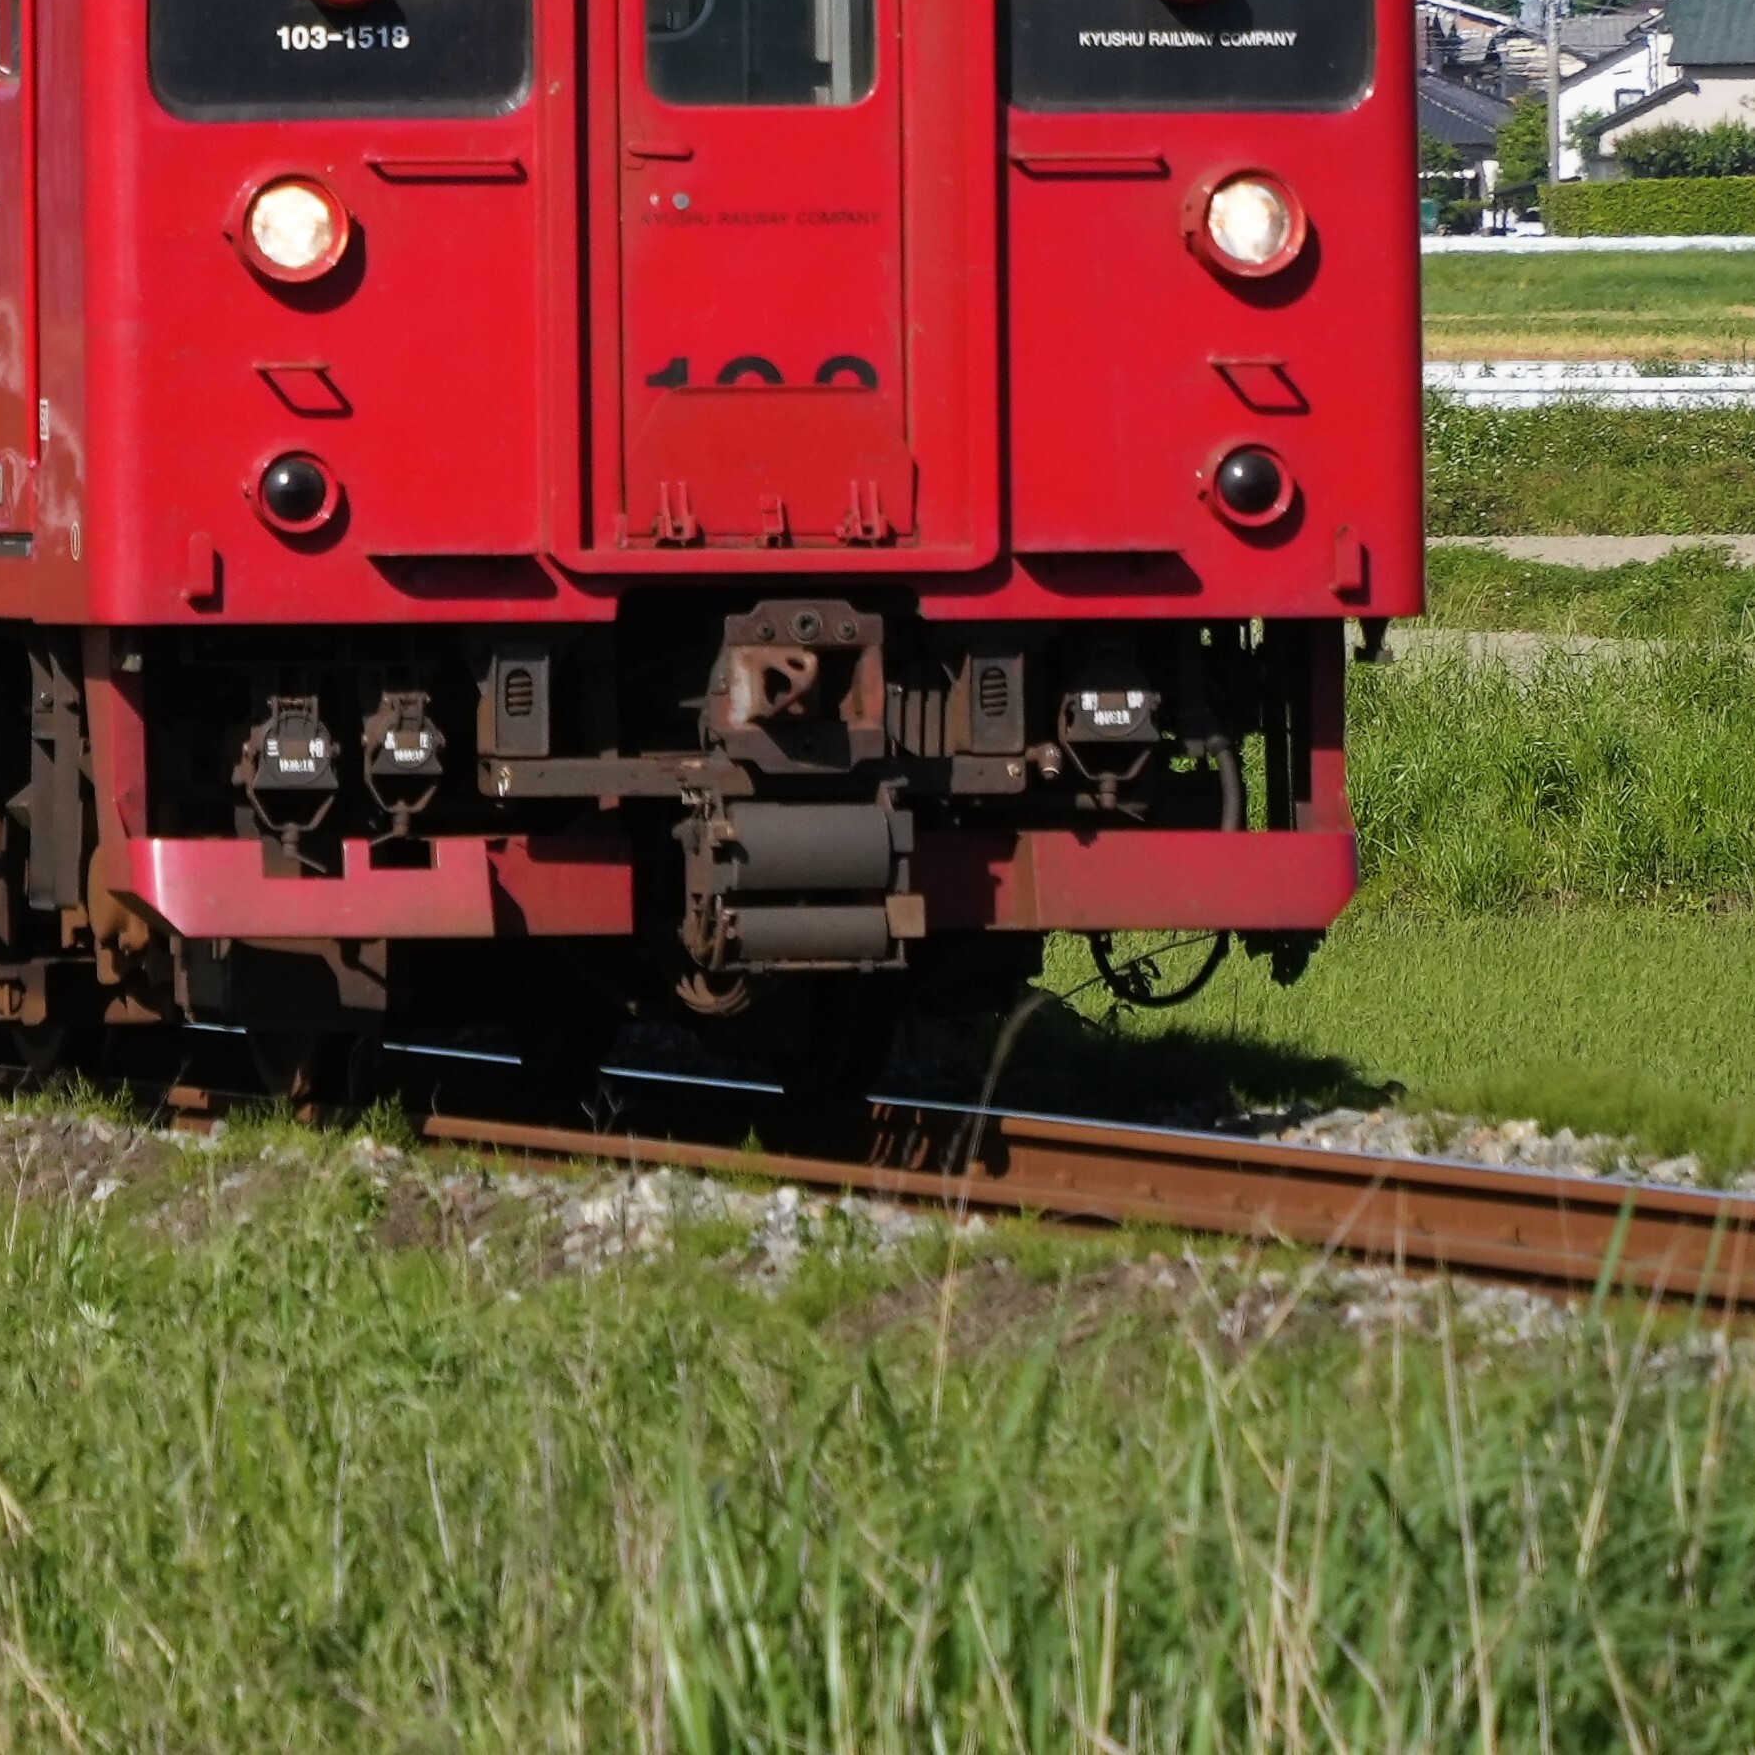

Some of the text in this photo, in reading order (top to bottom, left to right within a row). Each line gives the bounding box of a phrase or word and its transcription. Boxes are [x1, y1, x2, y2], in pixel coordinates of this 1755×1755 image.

[276, 25, 411, 51] 103-1518
[1078, 31, 1298, 48] KYUSHU RAILWAY COMPANY
